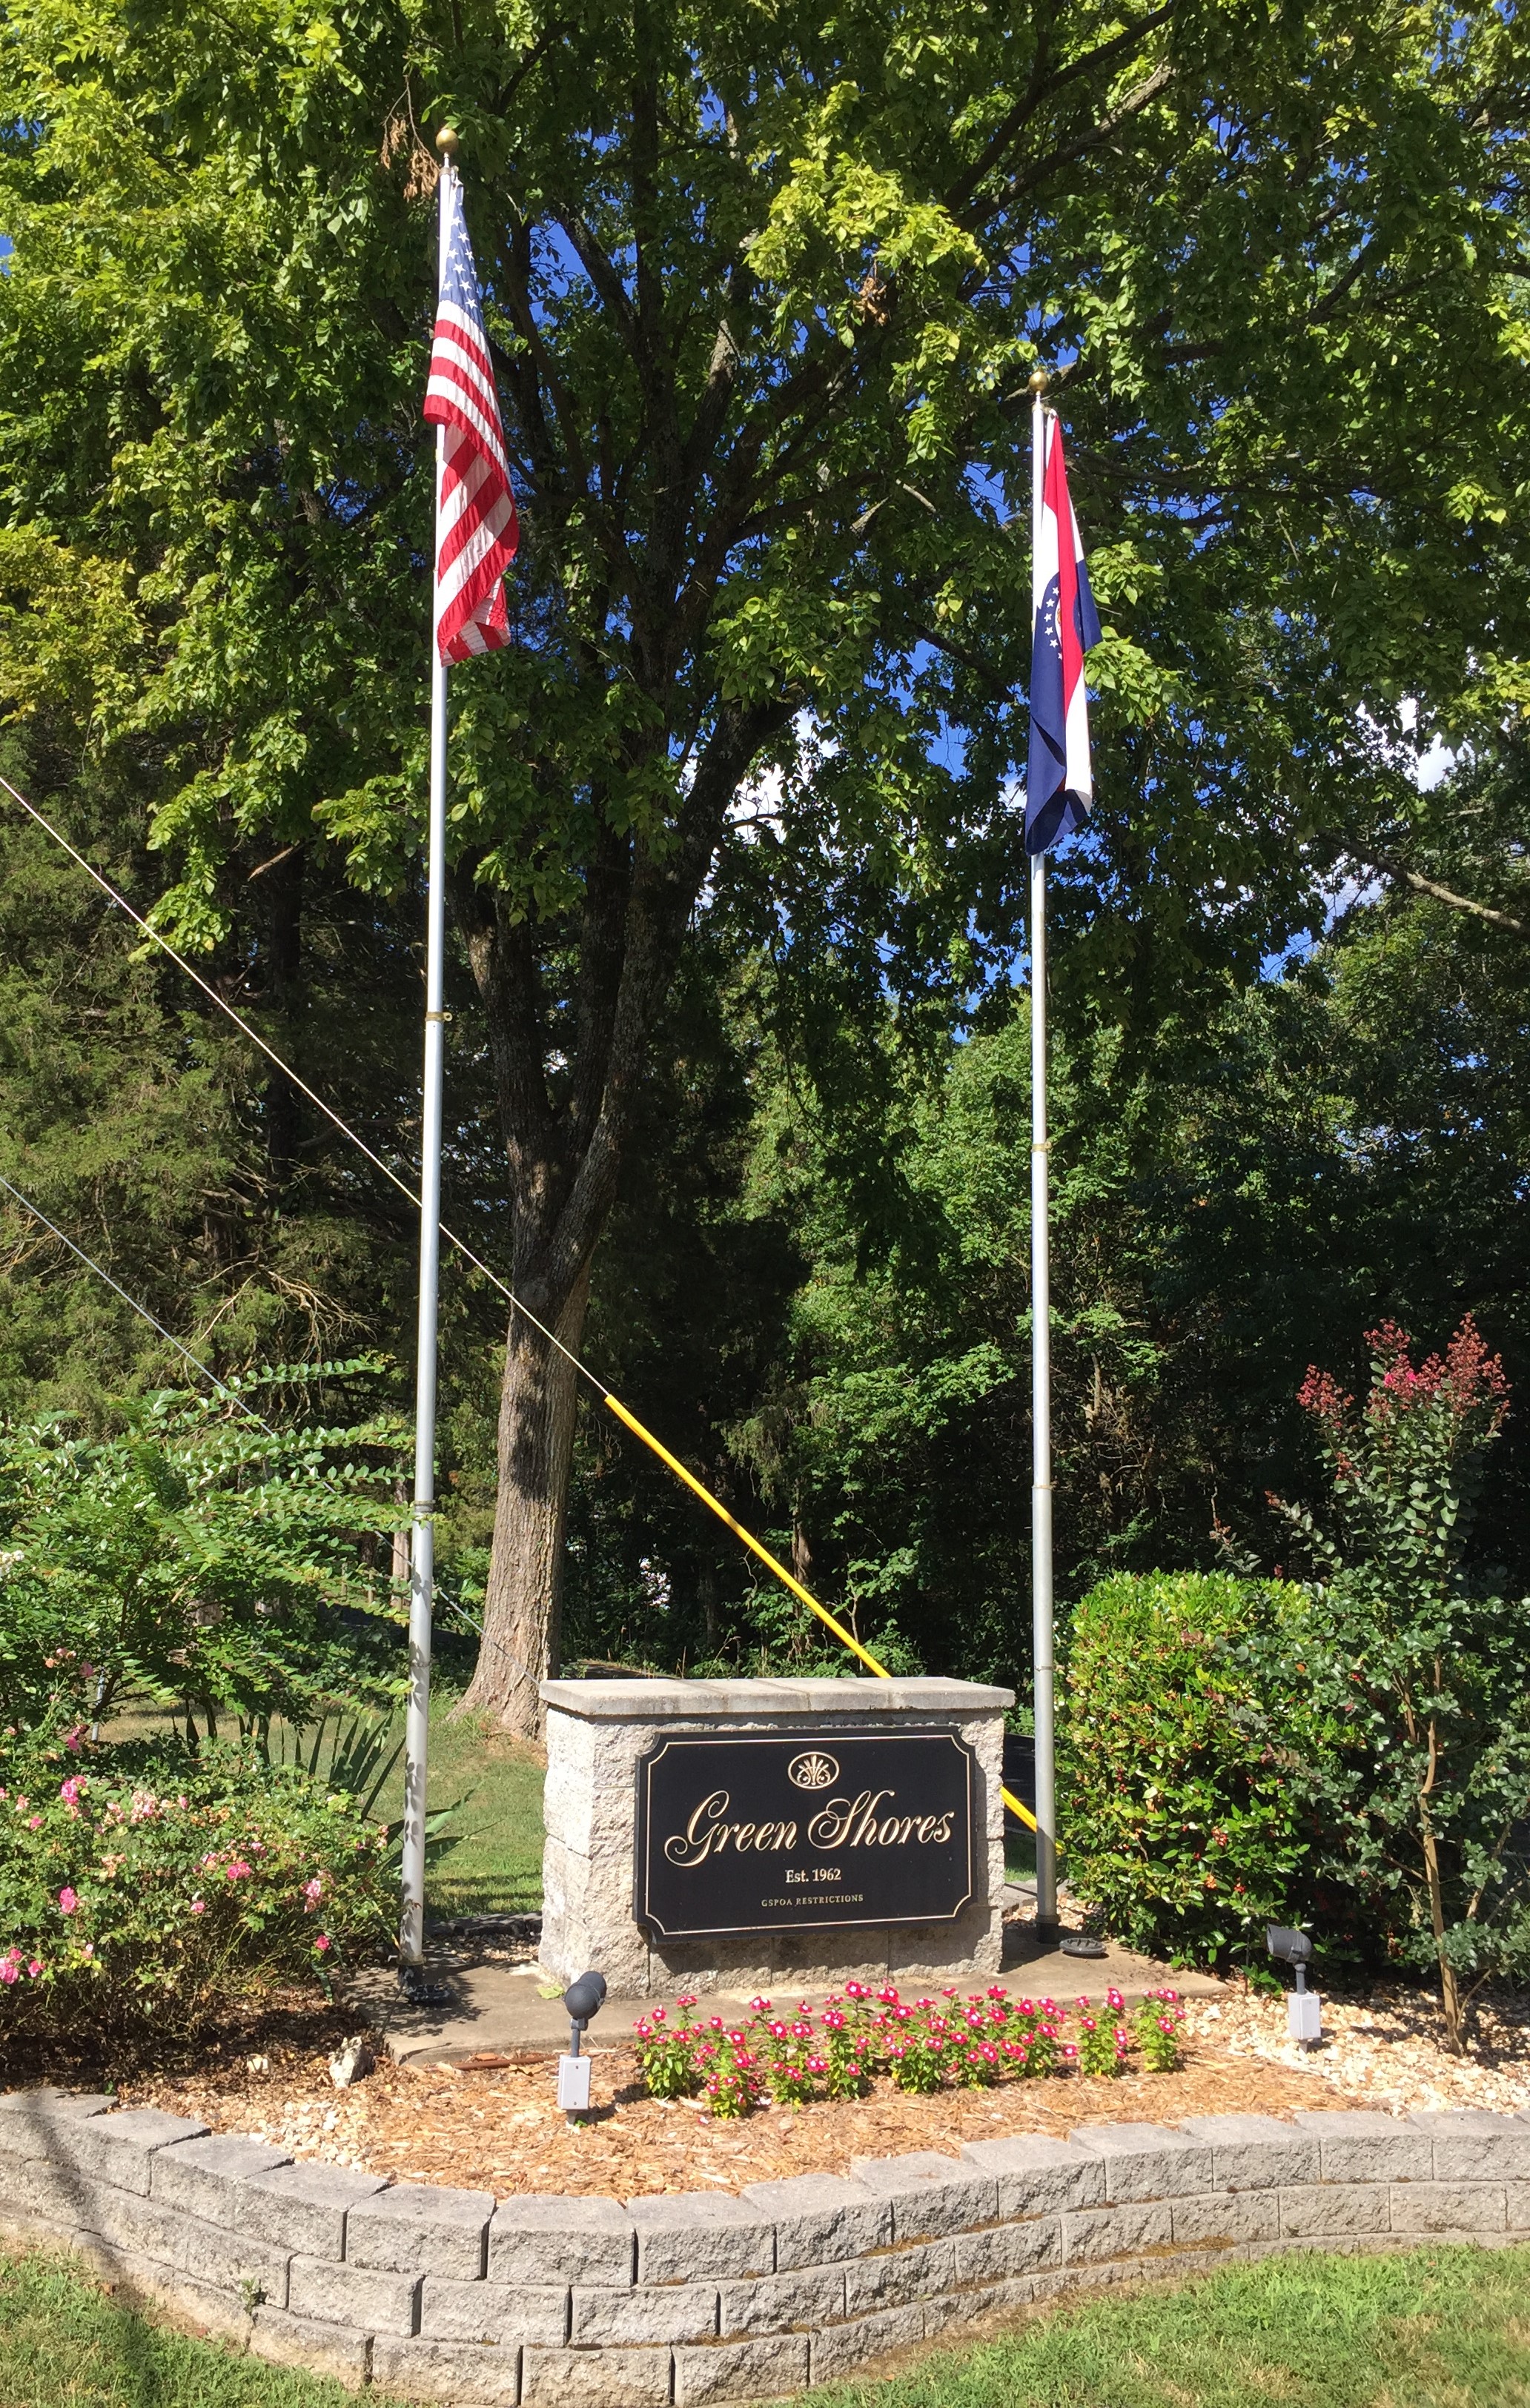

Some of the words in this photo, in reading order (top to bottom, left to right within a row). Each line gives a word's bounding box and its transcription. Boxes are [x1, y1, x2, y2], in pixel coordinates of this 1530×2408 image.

[664, 1790, 797, 1867] Green
[807, 1790, 955, 1850] Shores
[785, 1869, 809, 1883] Est.
[812, 1868, 842, 1882] 1962
[761, 1897, 793, 1908] GSPOA
[795, 1894, 864, 1906] RESTRICTIONS
